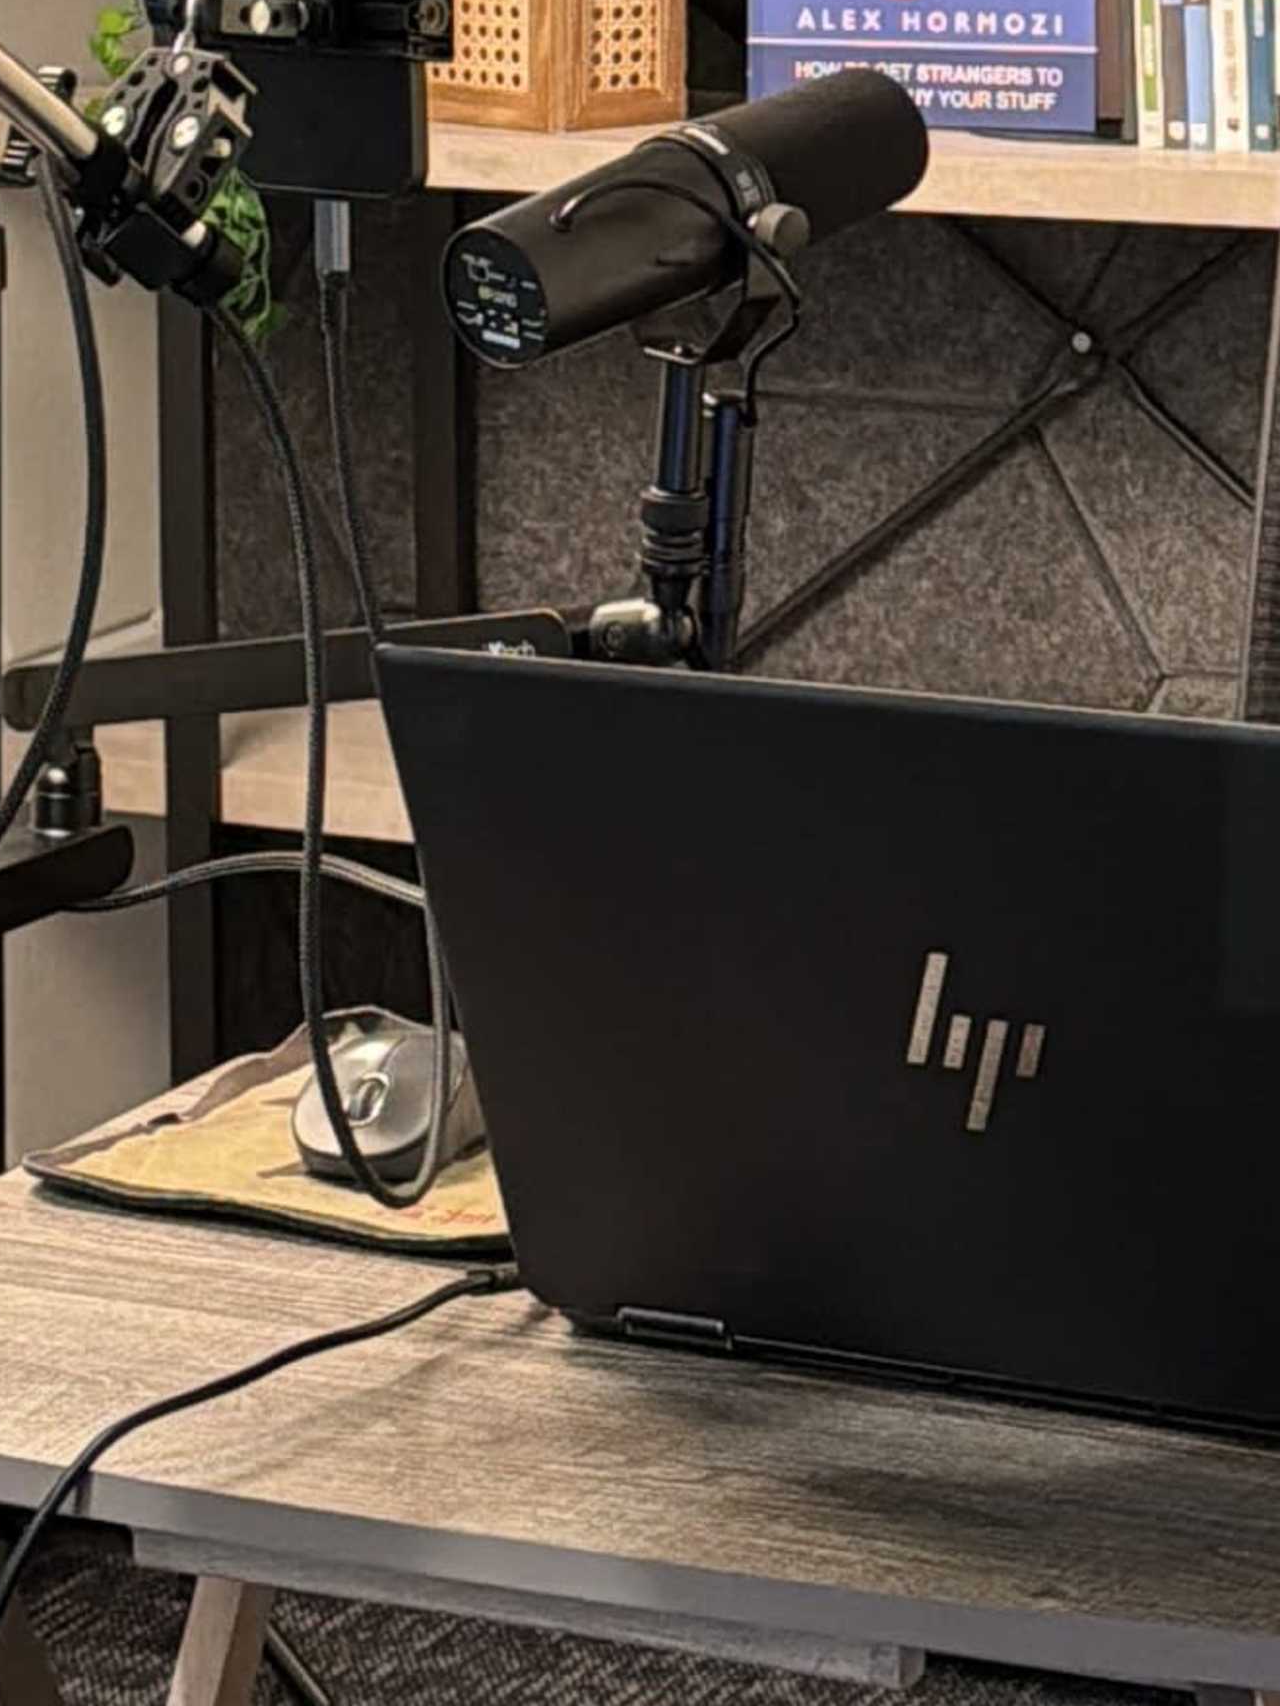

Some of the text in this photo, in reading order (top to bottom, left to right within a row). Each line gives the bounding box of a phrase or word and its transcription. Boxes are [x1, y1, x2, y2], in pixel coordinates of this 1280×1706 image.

[796, 7, 1064, 36] ALEX HORMOZI
[916, 65, 1033, 86] STRANGERS
[1037, 68, 1064, 87] TO
[938, 90, 992, 109] YOUR
[996, 93, 1058, 111] STUFF
[907, 951, 1046, 1131] hp
